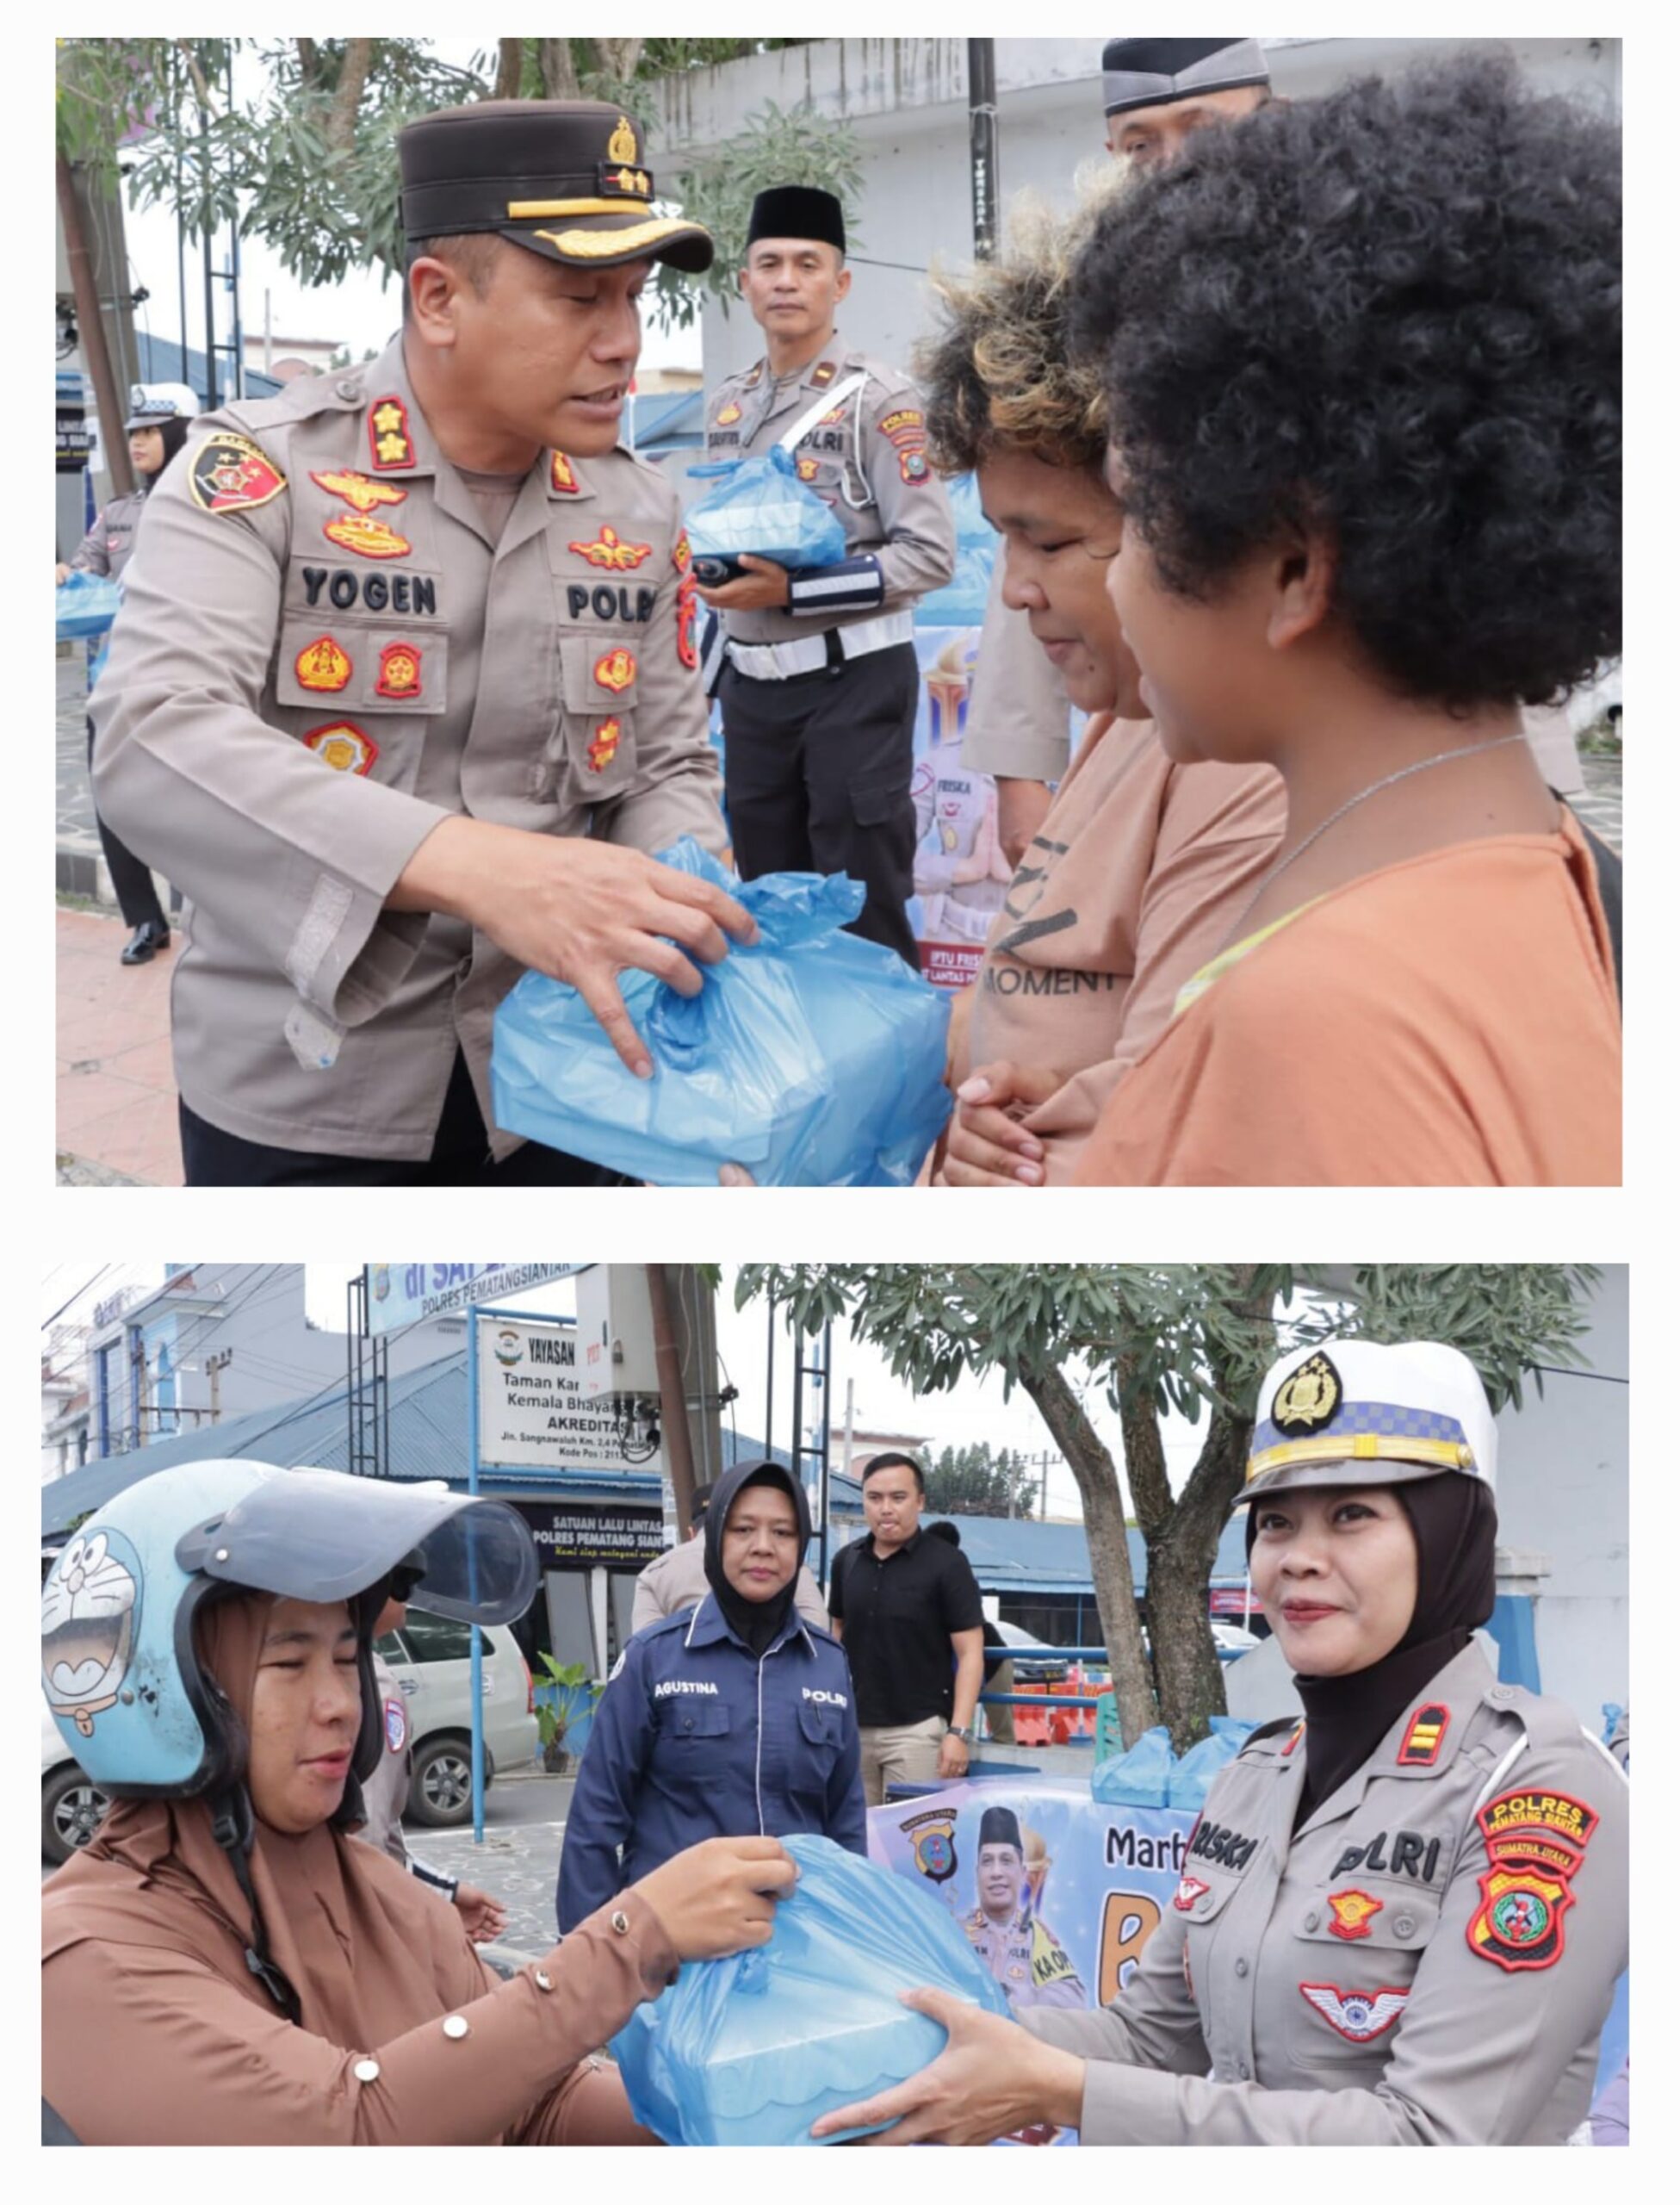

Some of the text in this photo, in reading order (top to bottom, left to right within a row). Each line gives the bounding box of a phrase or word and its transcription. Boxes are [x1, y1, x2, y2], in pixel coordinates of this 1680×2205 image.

[302, 566, 437, 615] YOGEN
[421, 1289, 461, 1317] POLRES
[529, 1337, 575, 1366] YAYASAN
[502, 1372, 553, 1389] Taman
[507, 1392, 563, 1409] Kemala
[559, 1447, 580, 1457] Kode
[584, 1448, 598, 1458] Pos
[553, 1516, 663, 1533] SATUAN LALU LINTAS
[532, 1530, 574, 1545] POLRES
[576, 1531, 635, 1548] PEMATANG
[654, 1680, 719, 1698] AGUSTINA
[802, 1686, 848, 1708] POLRI
[1492, 1795, 1584, 1823] POLRES
[1033, 1954, 1057, 1981] KA
